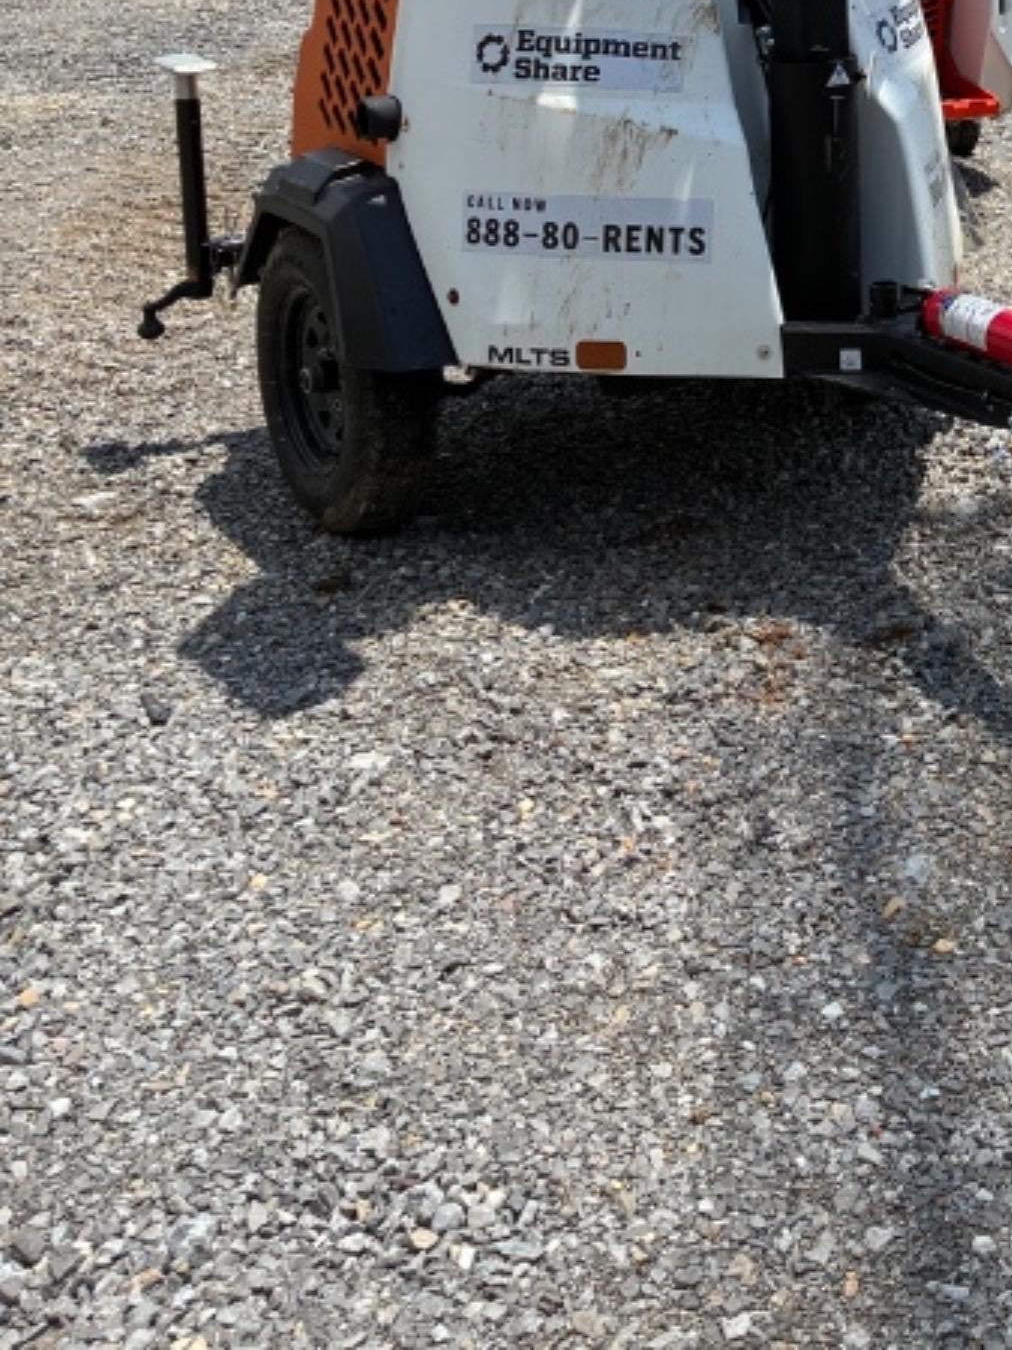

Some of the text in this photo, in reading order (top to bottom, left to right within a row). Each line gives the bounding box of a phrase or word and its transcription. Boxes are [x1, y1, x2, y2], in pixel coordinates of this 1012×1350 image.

[516, 29, 682, 60] Equipment
[514, 57, 601, 82] Share
[467, 195, 547, 212] CALL NOW
[466, 217, 706, 255] 888-80-RENTS
